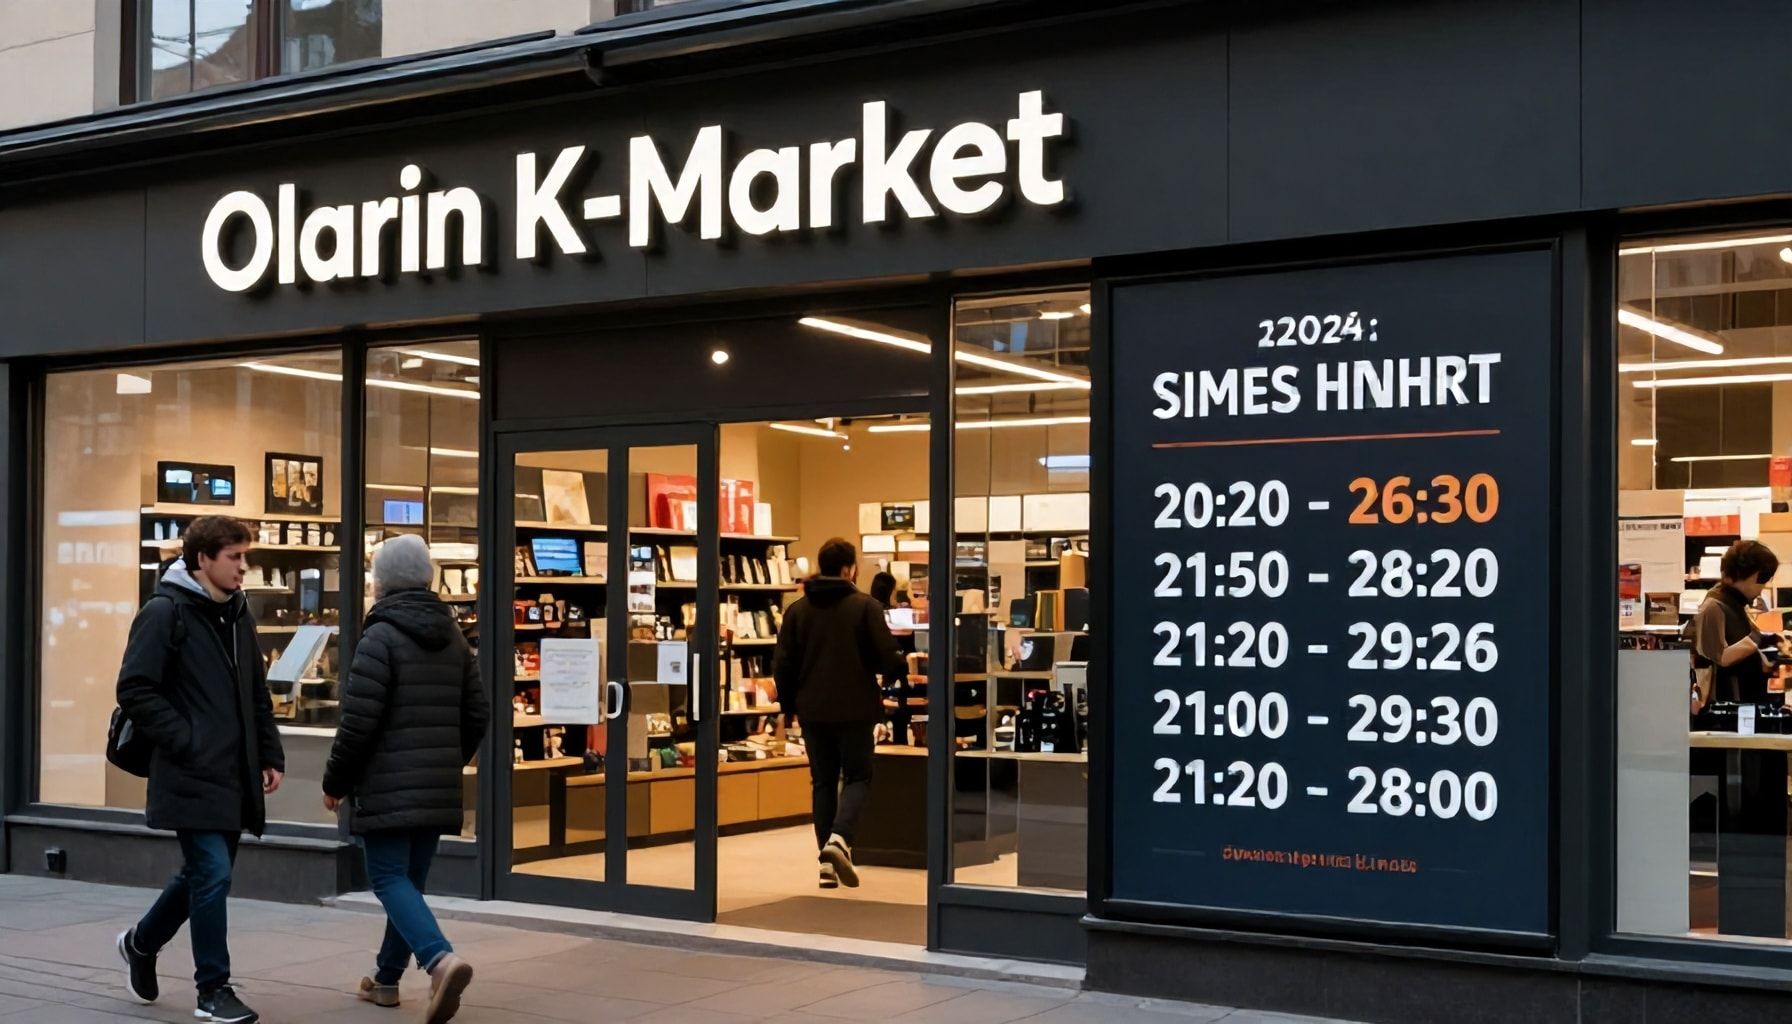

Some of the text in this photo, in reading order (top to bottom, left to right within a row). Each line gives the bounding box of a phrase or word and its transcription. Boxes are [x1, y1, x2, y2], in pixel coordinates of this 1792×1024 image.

[202, 90, 1064, 292] Olarin K-Market
[1152, 352, 1502, 420] SIMES HNHRT
[1154, 479, 1290, 529] 20:20
[1348, 472, 1500, 524] 26:30
[1153, 550, 1290, 598] 21:50
[1347, 547, 1499, 598] 28:20
[1152, 620, 1289, 669] 21:20
[1347, 621, 1499, 673] 29:26
[1152, 688, 1289, 740] 21:00
[1346, 693, 1499, 747] 29:30
[1152, 757, 1289, 810] 21:20
[1347, 765, 1498, 822] 28:00
